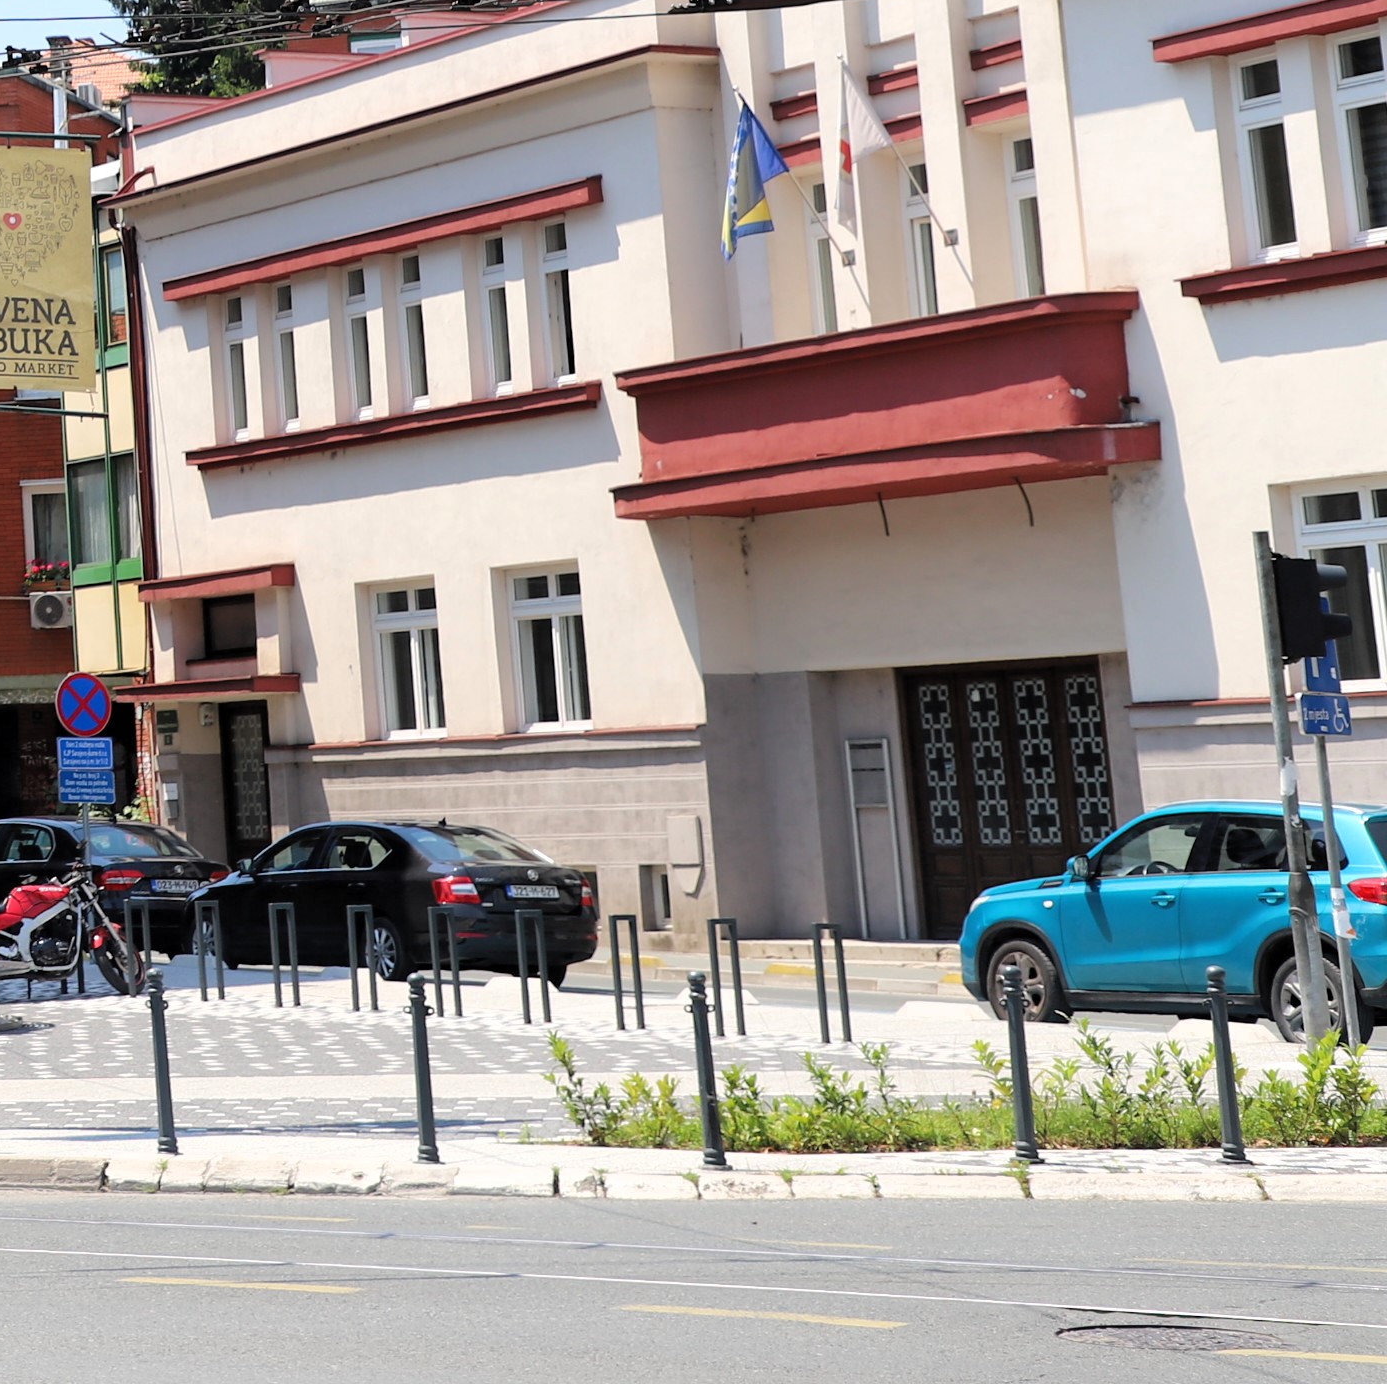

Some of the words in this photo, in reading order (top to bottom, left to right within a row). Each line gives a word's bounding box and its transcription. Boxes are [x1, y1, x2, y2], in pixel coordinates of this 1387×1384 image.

[14, 362, 75, 375] MARKET
[1303, 708, 1308, 721] 2
[1309, 708, 1330, 723] mjesta
